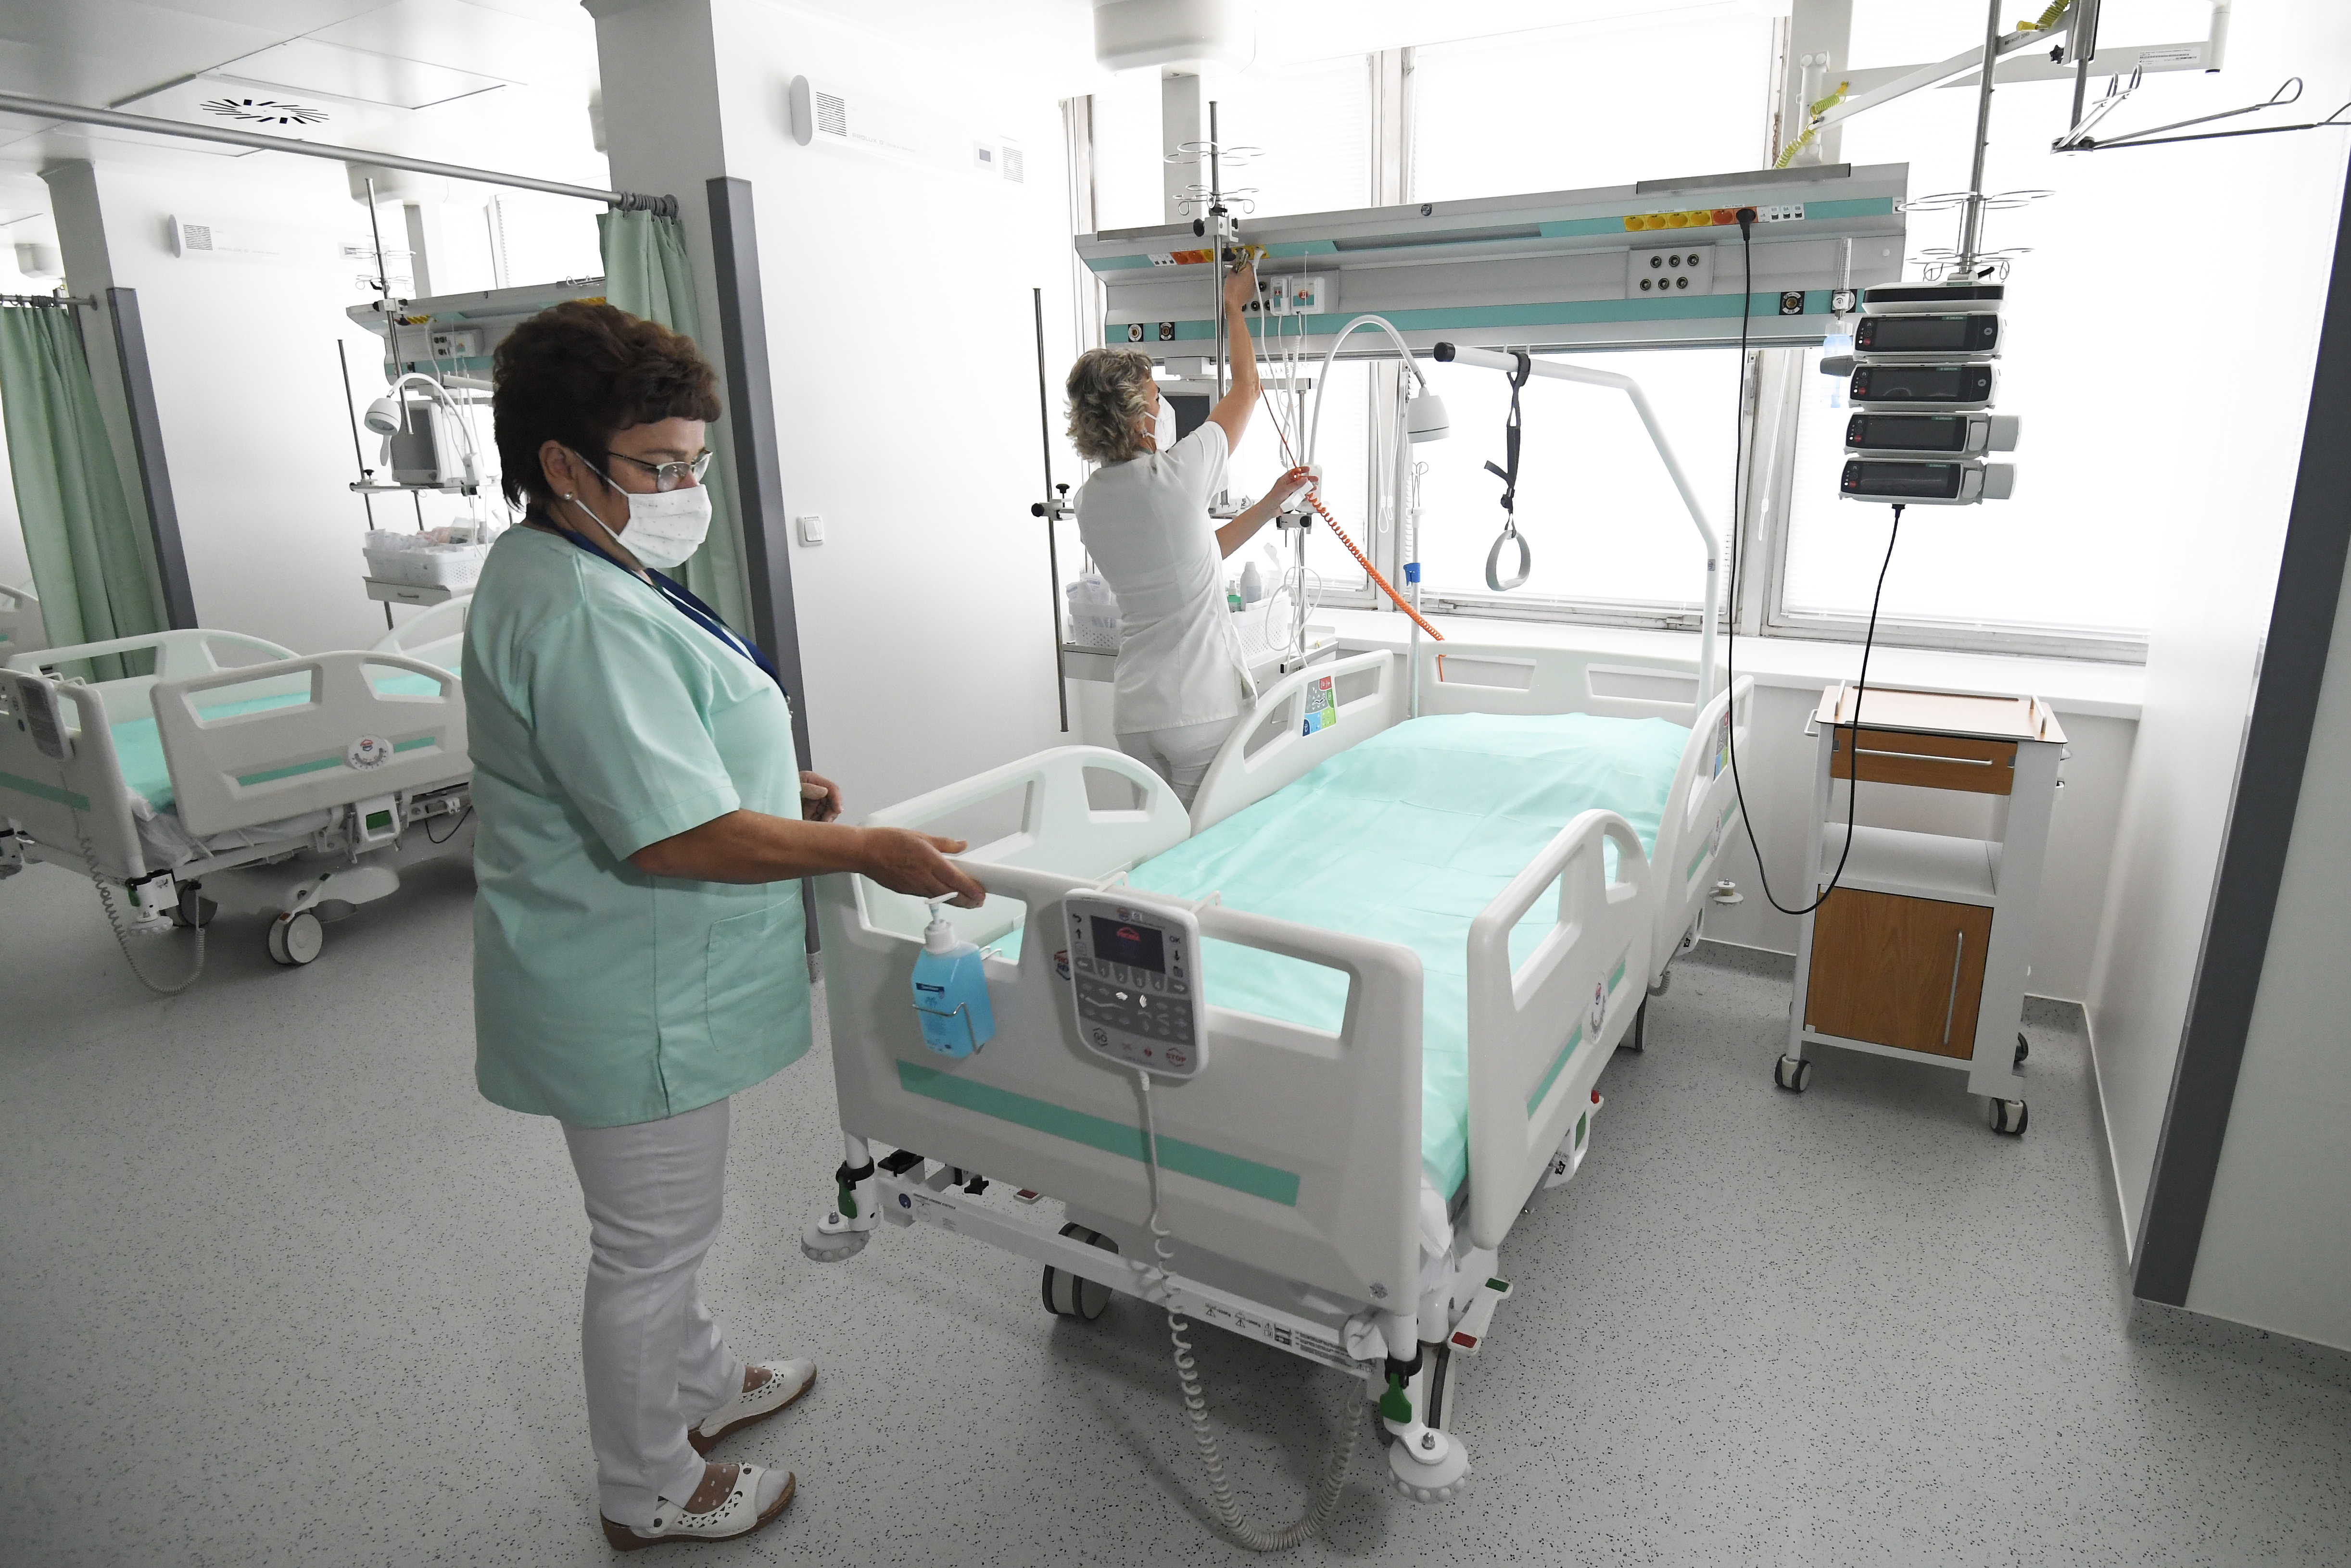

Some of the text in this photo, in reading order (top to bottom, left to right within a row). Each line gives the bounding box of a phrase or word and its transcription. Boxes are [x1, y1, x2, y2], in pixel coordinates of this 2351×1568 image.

[852, 133, 877, 143] PROLUX
[1169, 935, 1181, 944] OK
[1118, 973, 1125, 982] 2
[1166, 1053, 1187, 1063] STOP
